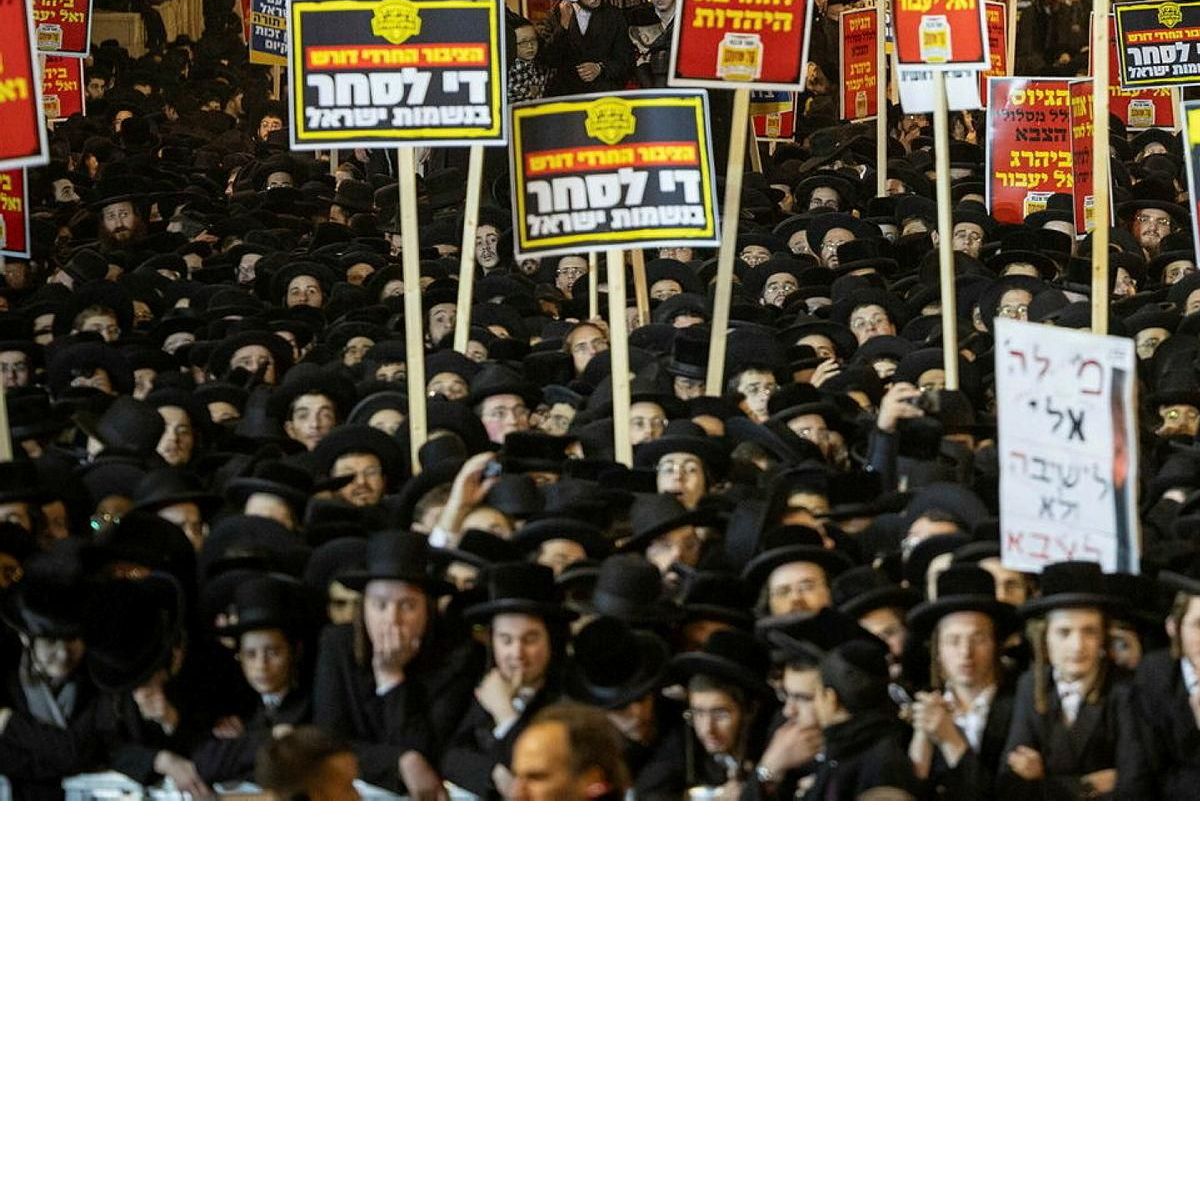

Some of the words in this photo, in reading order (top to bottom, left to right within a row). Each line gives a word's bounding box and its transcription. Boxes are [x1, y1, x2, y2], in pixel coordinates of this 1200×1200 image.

[59, 8, 85, 23] ואל
[253, 14, 279, 27] תורה
[692, 7, 793, 32] היהדות
[255, 26, 280, 39] זכות
[1127, 32, 1153, 42] דורש
[1155, 30, 1183, 40] החרדי
[310, 50, 359, 67] דורש
[362, 48, 418, 64] החרדי
[418, 46, 485, 62] הציבור
[1127, 41, 1190, 66] לסחר
[1128, 65, 1169, 78] ישראל
[307, 67, 432, 107] לסחר
[442, 70, 489, 104] די
[1011, 88, 1069, 106] הגיוס
[305, 107, 388, 129] ישראל
[391, 105, 491, 126] בנשמות
[1016, 126, 1067, 142] הצבא
[529, 152, 574, 171] דורש
[577, 148, 634, 167] החרדי
[637, 145, 697, 163] הציבור
[1010, 150, 1072, 168] ביהרג
[659, 170, 701, 204] די
[995, 171, 1048, 188] יעבור
[527, 167, 648, 214] לסחר
[527, 210, 607, 236] ישראל
[610, 205, 706, 229] בנשמות
[1038, 497, 1080, 521] לא
